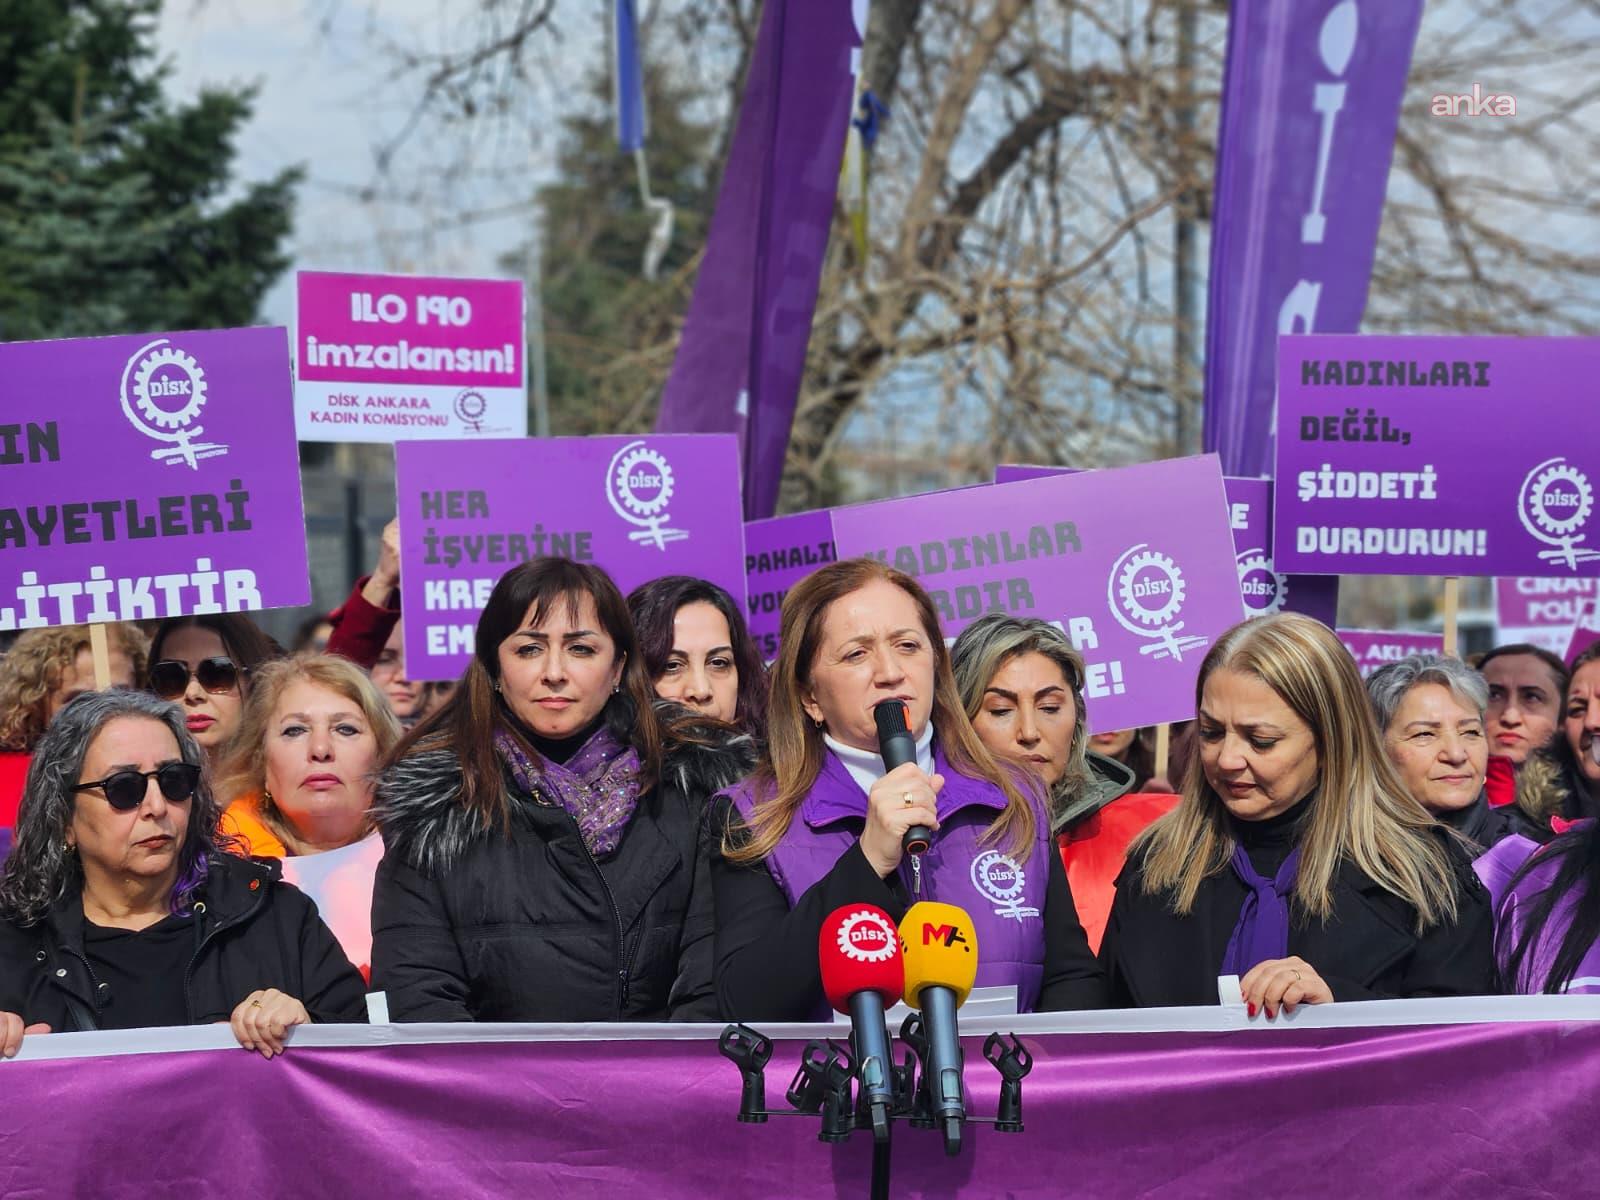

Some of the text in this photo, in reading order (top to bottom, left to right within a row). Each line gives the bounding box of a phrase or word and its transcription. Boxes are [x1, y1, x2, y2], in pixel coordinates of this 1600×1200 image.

[351, 292, 473, 327] ILO 190
[306, 335, 515, 374] imzalansın!
[1301, 360, 1491, 387] KADINLARI
[150, 374, 192, 397] DİSK
[327, 392, 431, 410] DİSK ANKARA
[310, 411, 449, 427] KADIN KOMİSYONU
[1300, 408, 1412, 445] DEĞİL,
[630, 470, 662, 489] DİSK
[1297, 463, 1437, 502] ŞİDDETİ
[421, 490, 490, 520] HER
[1543, 488, 1580, 506] DİSK
[423, 524, 594, 569] İŞYERİNE
[424, 579, 499, 611] KRE
[1133, 576, 1172, 598] DİSK
[1242, 577, 1276, 595] DİSK
[988, 869, 1016, 881] DİSK
[851, 926, 888, 943] DİSK
